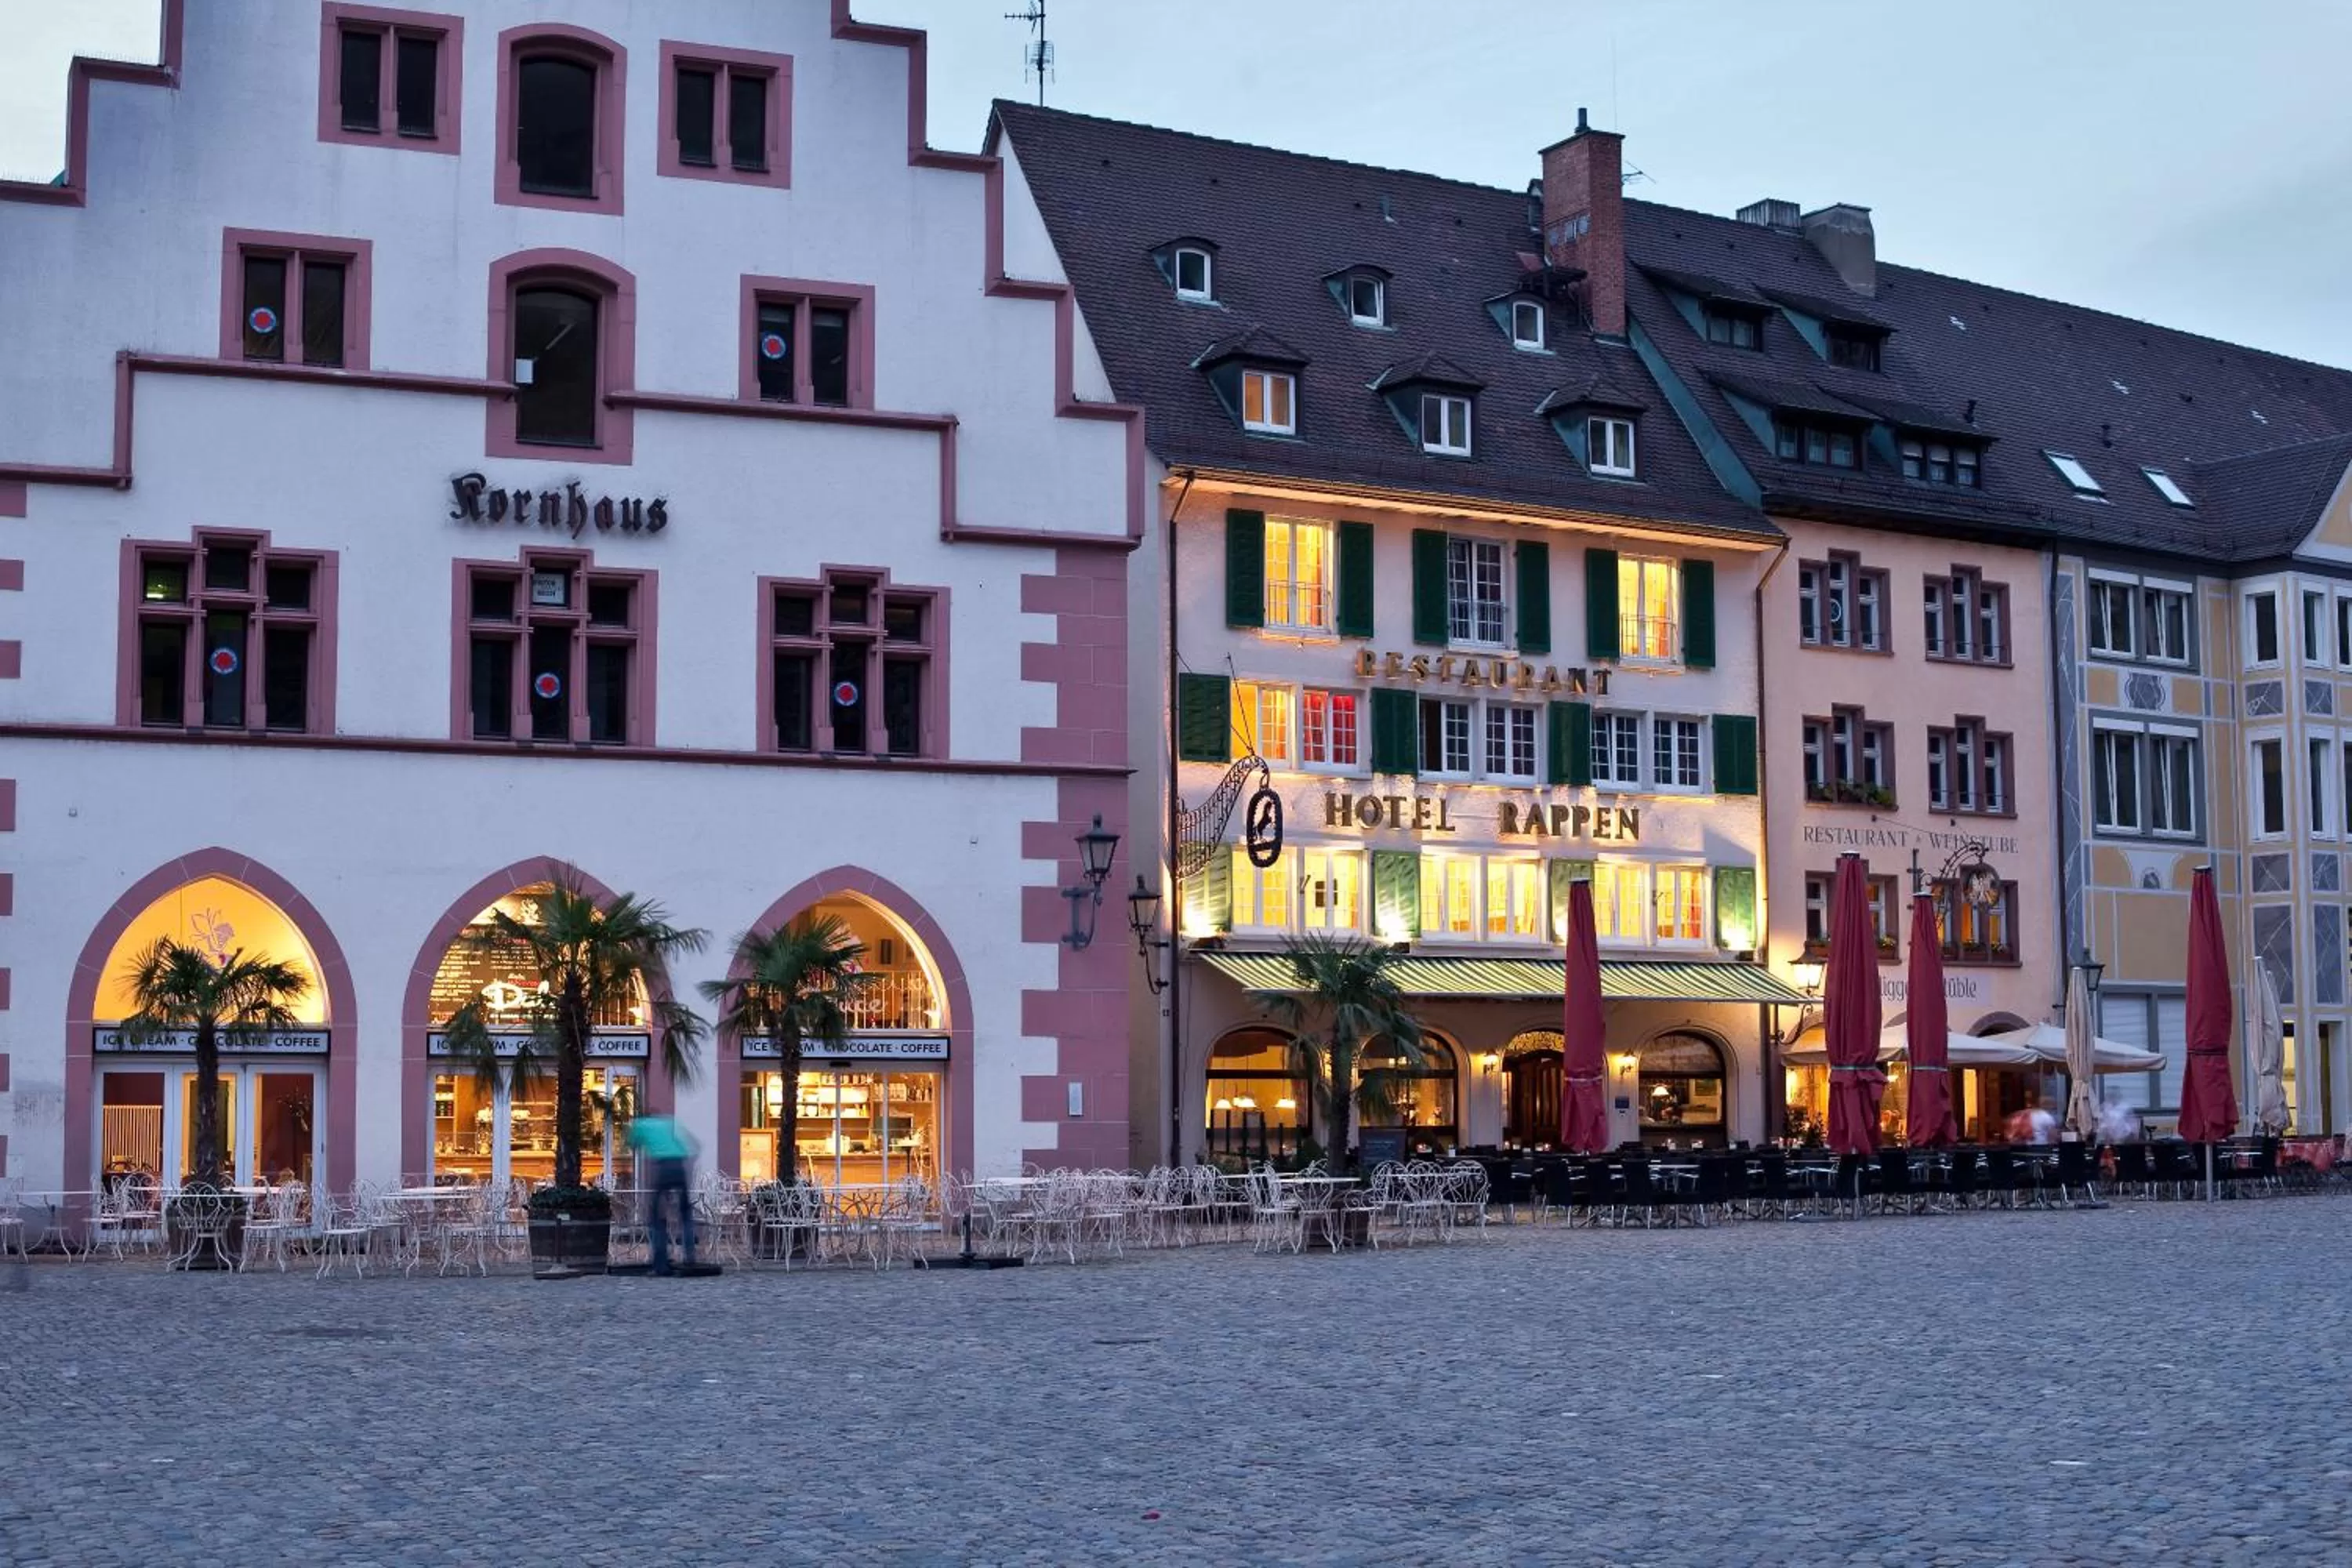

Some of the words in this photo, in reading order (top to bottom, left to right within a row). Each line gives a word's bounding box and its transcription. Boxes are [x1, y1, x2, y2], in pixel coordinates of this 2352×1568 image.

[449, 473, 667, 539] Kornhaus
[1356, 648, 1613, 695] RESTAURANT
[1326, 793, 1456, 832] HOTEL
[1498, 800, 1639, 840] RAPPEN
[1803, 826, 1910, 848] RESTAURANT
[1928, 832, 2020, 854] WEINSTUBE
[103, 1034, 123, 1046] IC
[275, 1037, 321, 1047] COFFEE
[598, 1040, 641, 1051] COFFEE
[750, 1042, 768, 1051] ICE
[823, 1042, 892, 1053] CHOCOLATE
[901, 1044, 942, 1053] COFFEE
